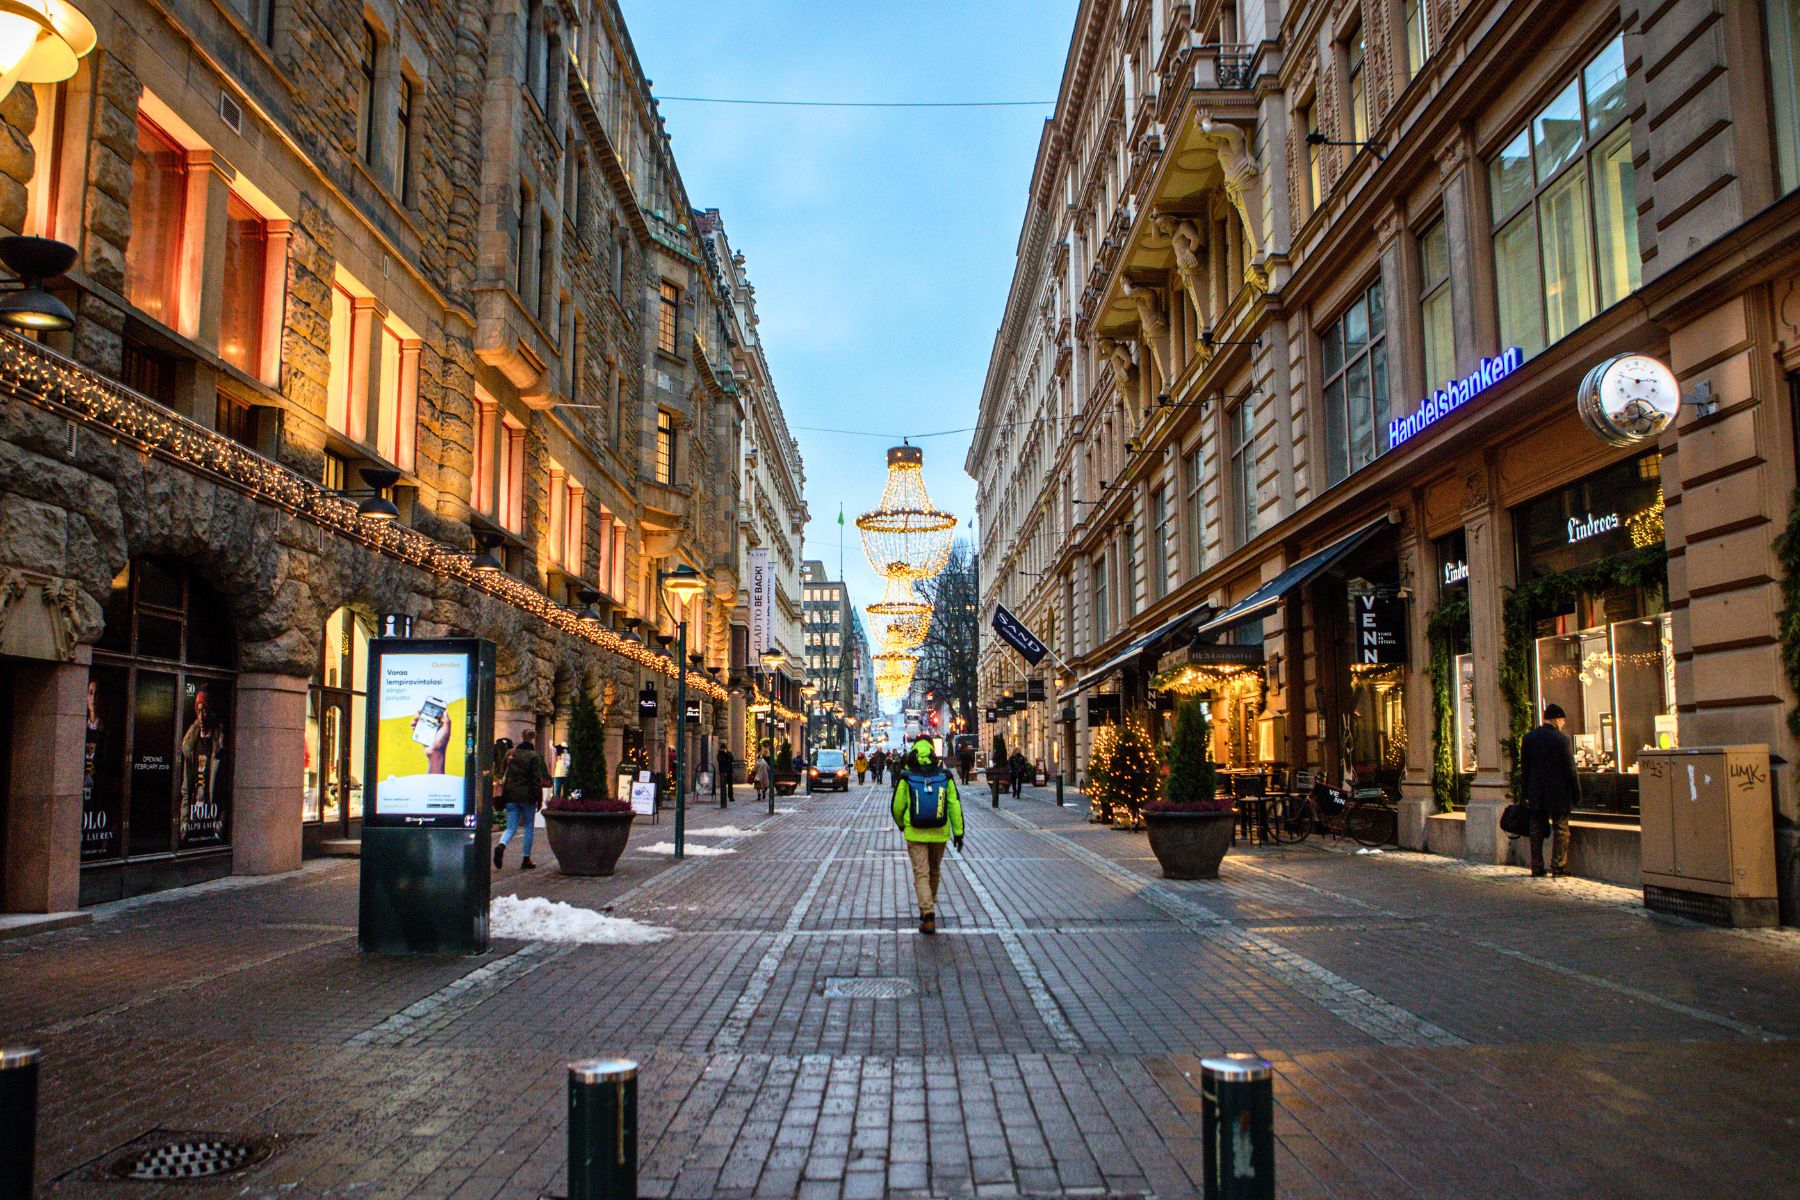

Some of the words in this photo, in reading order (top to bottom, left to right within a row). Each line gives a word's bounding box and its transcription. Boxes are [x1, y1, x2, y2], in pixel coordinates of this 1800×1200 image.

[1389, 346, 1522, 449] Handelsbanken
[1567, 512, 1619, 544] Lindroos
[754, 566, 763, 594] BACK!
[754, 595, 763, 608] BE
[754, 608, 762, 623] TO
[754, 624, 762, 651] GLAD
[997, 612, 1040, 653] SAND
[1361, 595, 1378, 664] VENN
[186, 683, 195, 694] 50
[190, 803, 218, 820] POLO
[86, 831, 113, 841] LAUREN
